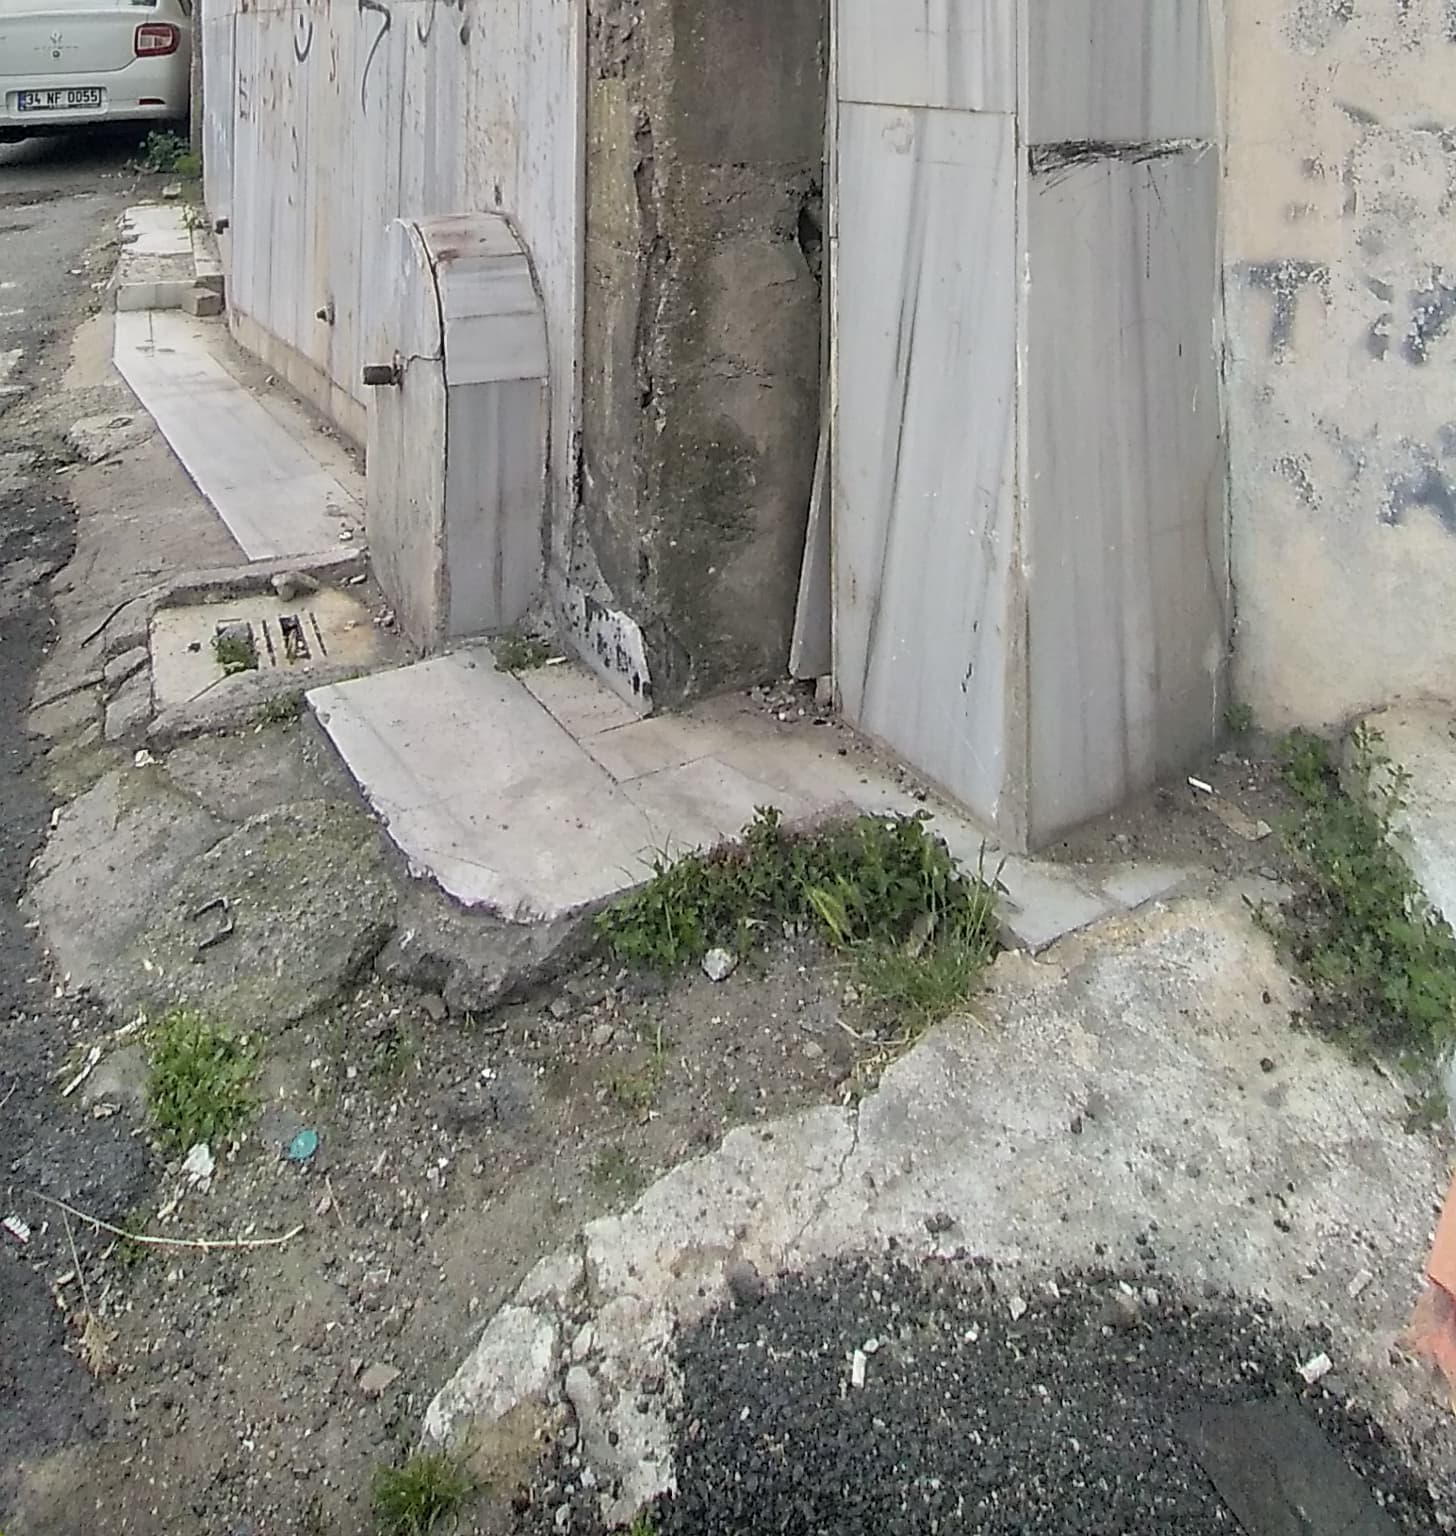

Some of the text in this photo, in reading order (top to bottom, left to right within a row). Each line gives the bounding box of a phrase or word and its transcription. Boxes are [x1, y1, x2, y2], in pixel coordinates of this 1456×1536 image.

[26, 90, 98, 105] 34 NF 0055
